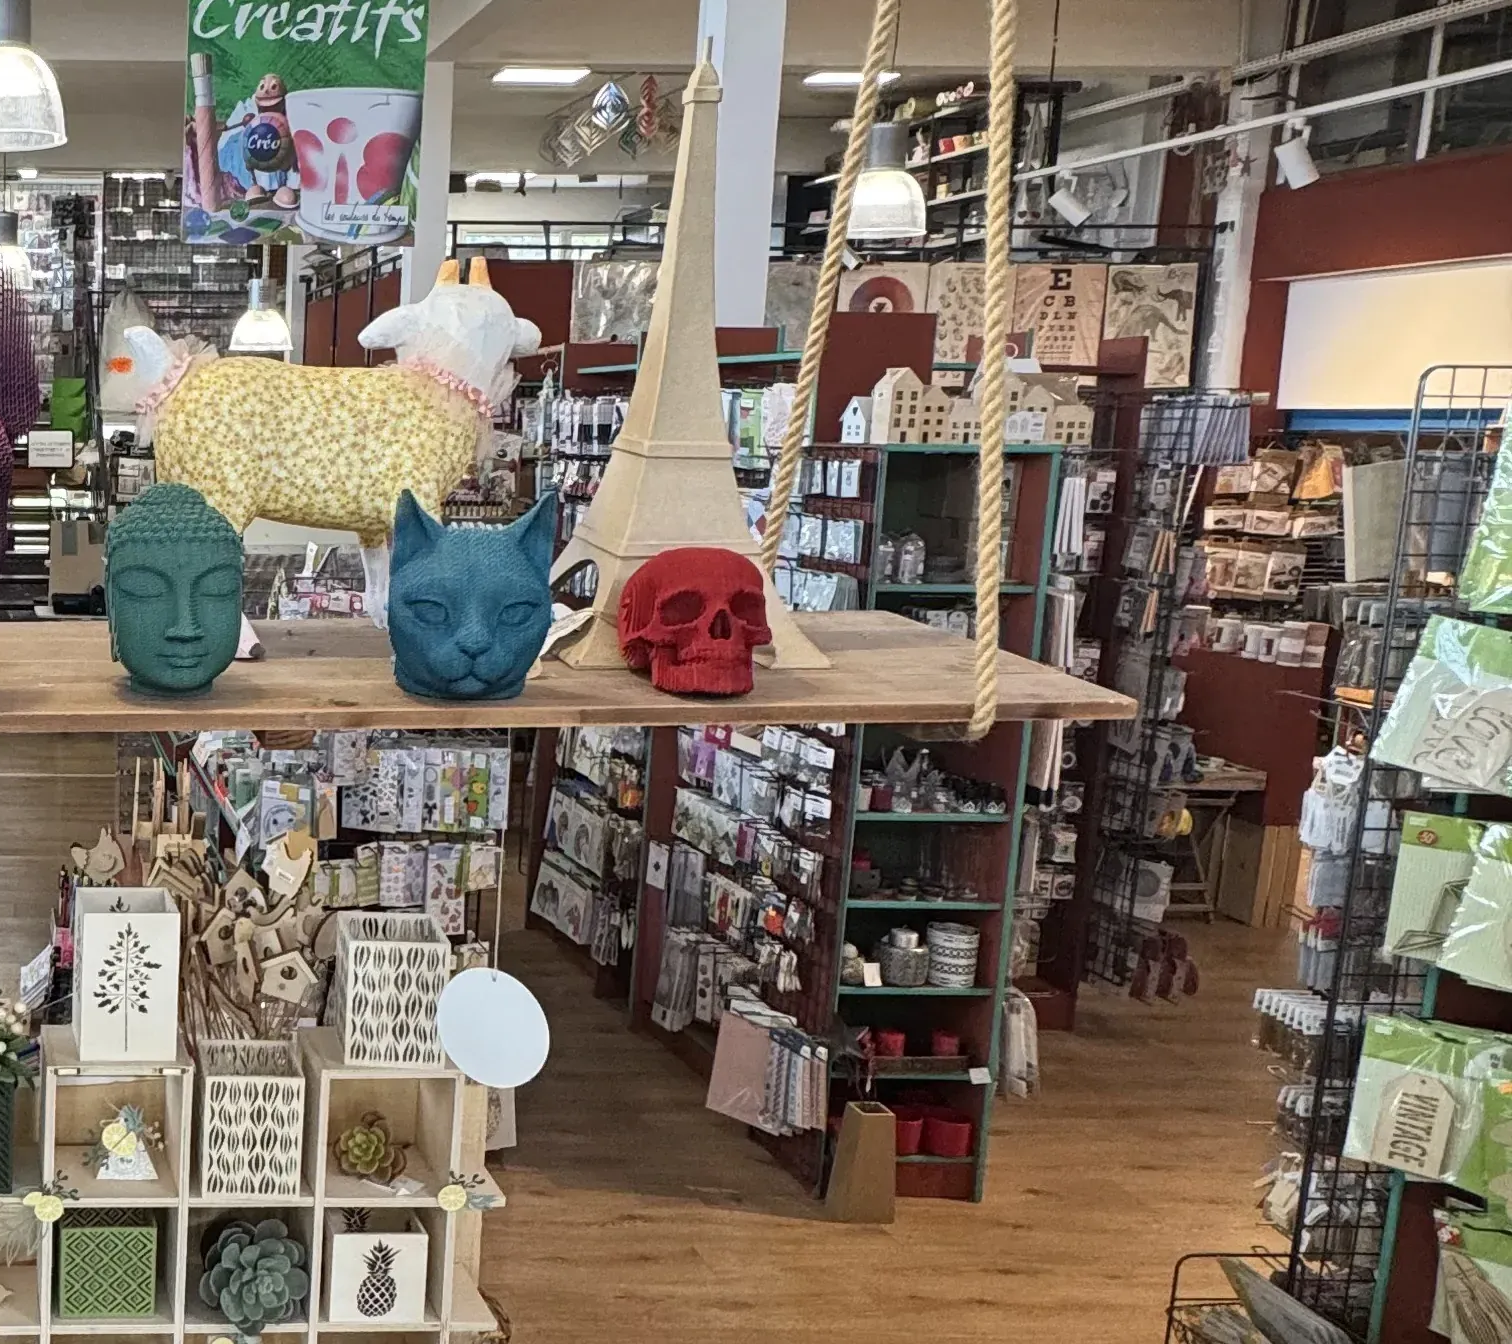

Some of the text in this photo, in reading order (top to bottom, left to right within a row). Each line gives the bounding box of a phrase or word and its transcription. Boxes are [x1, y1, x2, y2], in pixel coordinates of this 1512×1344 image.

[248, 133, 281, 150] Créo
[1049, 268, 1073, 291] E
[1388, 1092, 1440, 1169] VINTAGE
